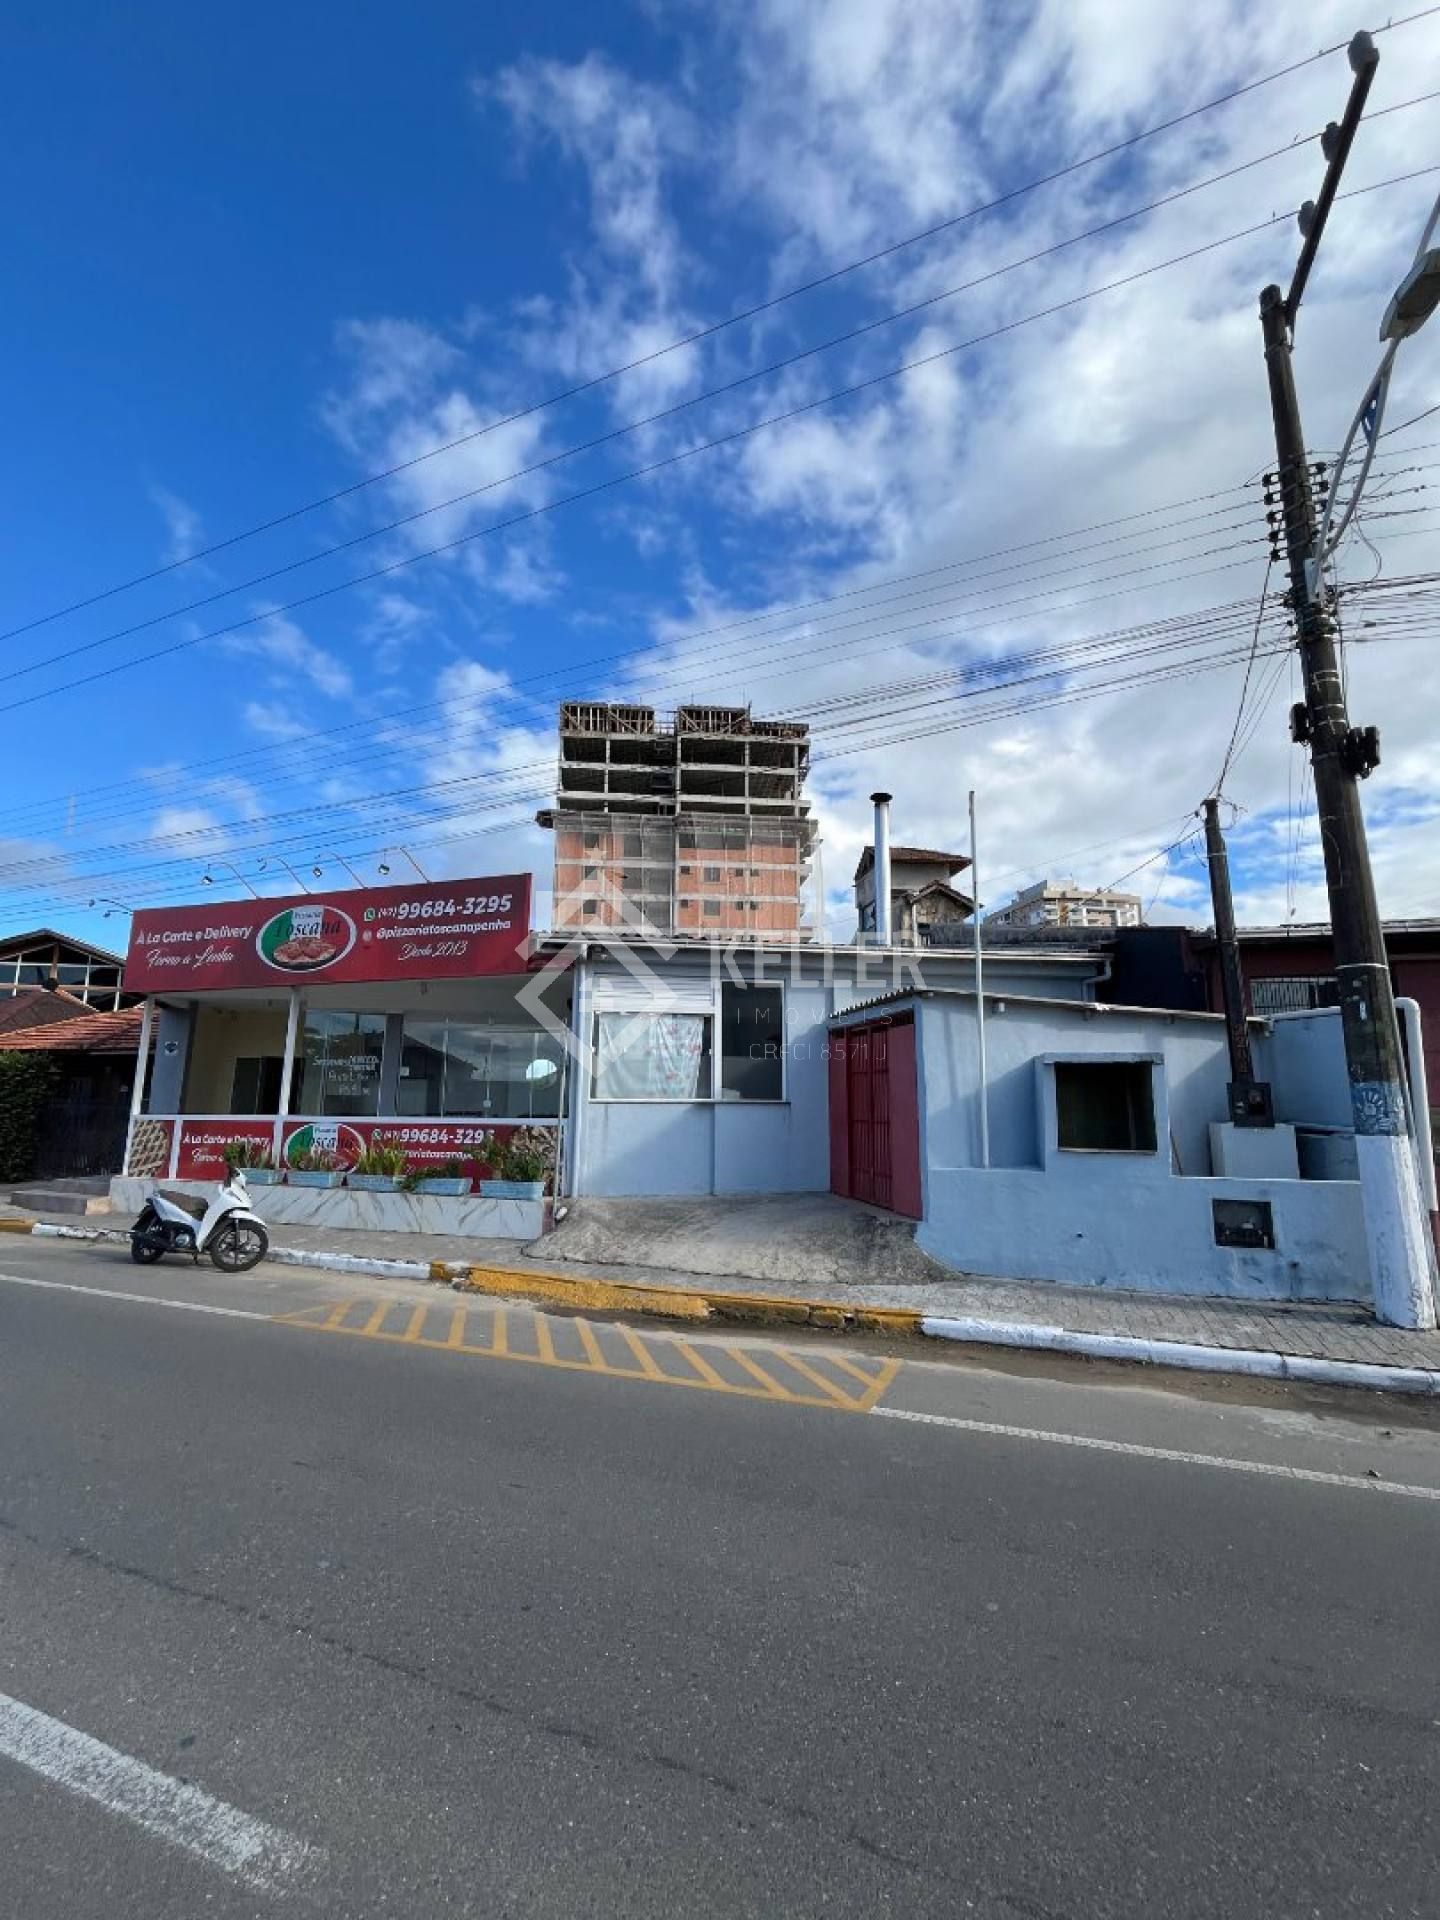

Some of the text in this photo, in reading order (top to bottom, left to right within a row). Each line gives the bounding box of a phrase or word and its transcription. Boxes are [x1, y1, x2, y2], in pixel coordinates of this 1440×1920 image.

[398, 894, 513, 919] 99684-3295
[147, 932, 161, 944] La
[162, 930, 193, 943] Carte
[195, 930, 202, 941] e
[204, 925, 253, 940] Delivery
[192, 1135, 202, 1144] La
[203, 1134, 226, 1144] Carte
